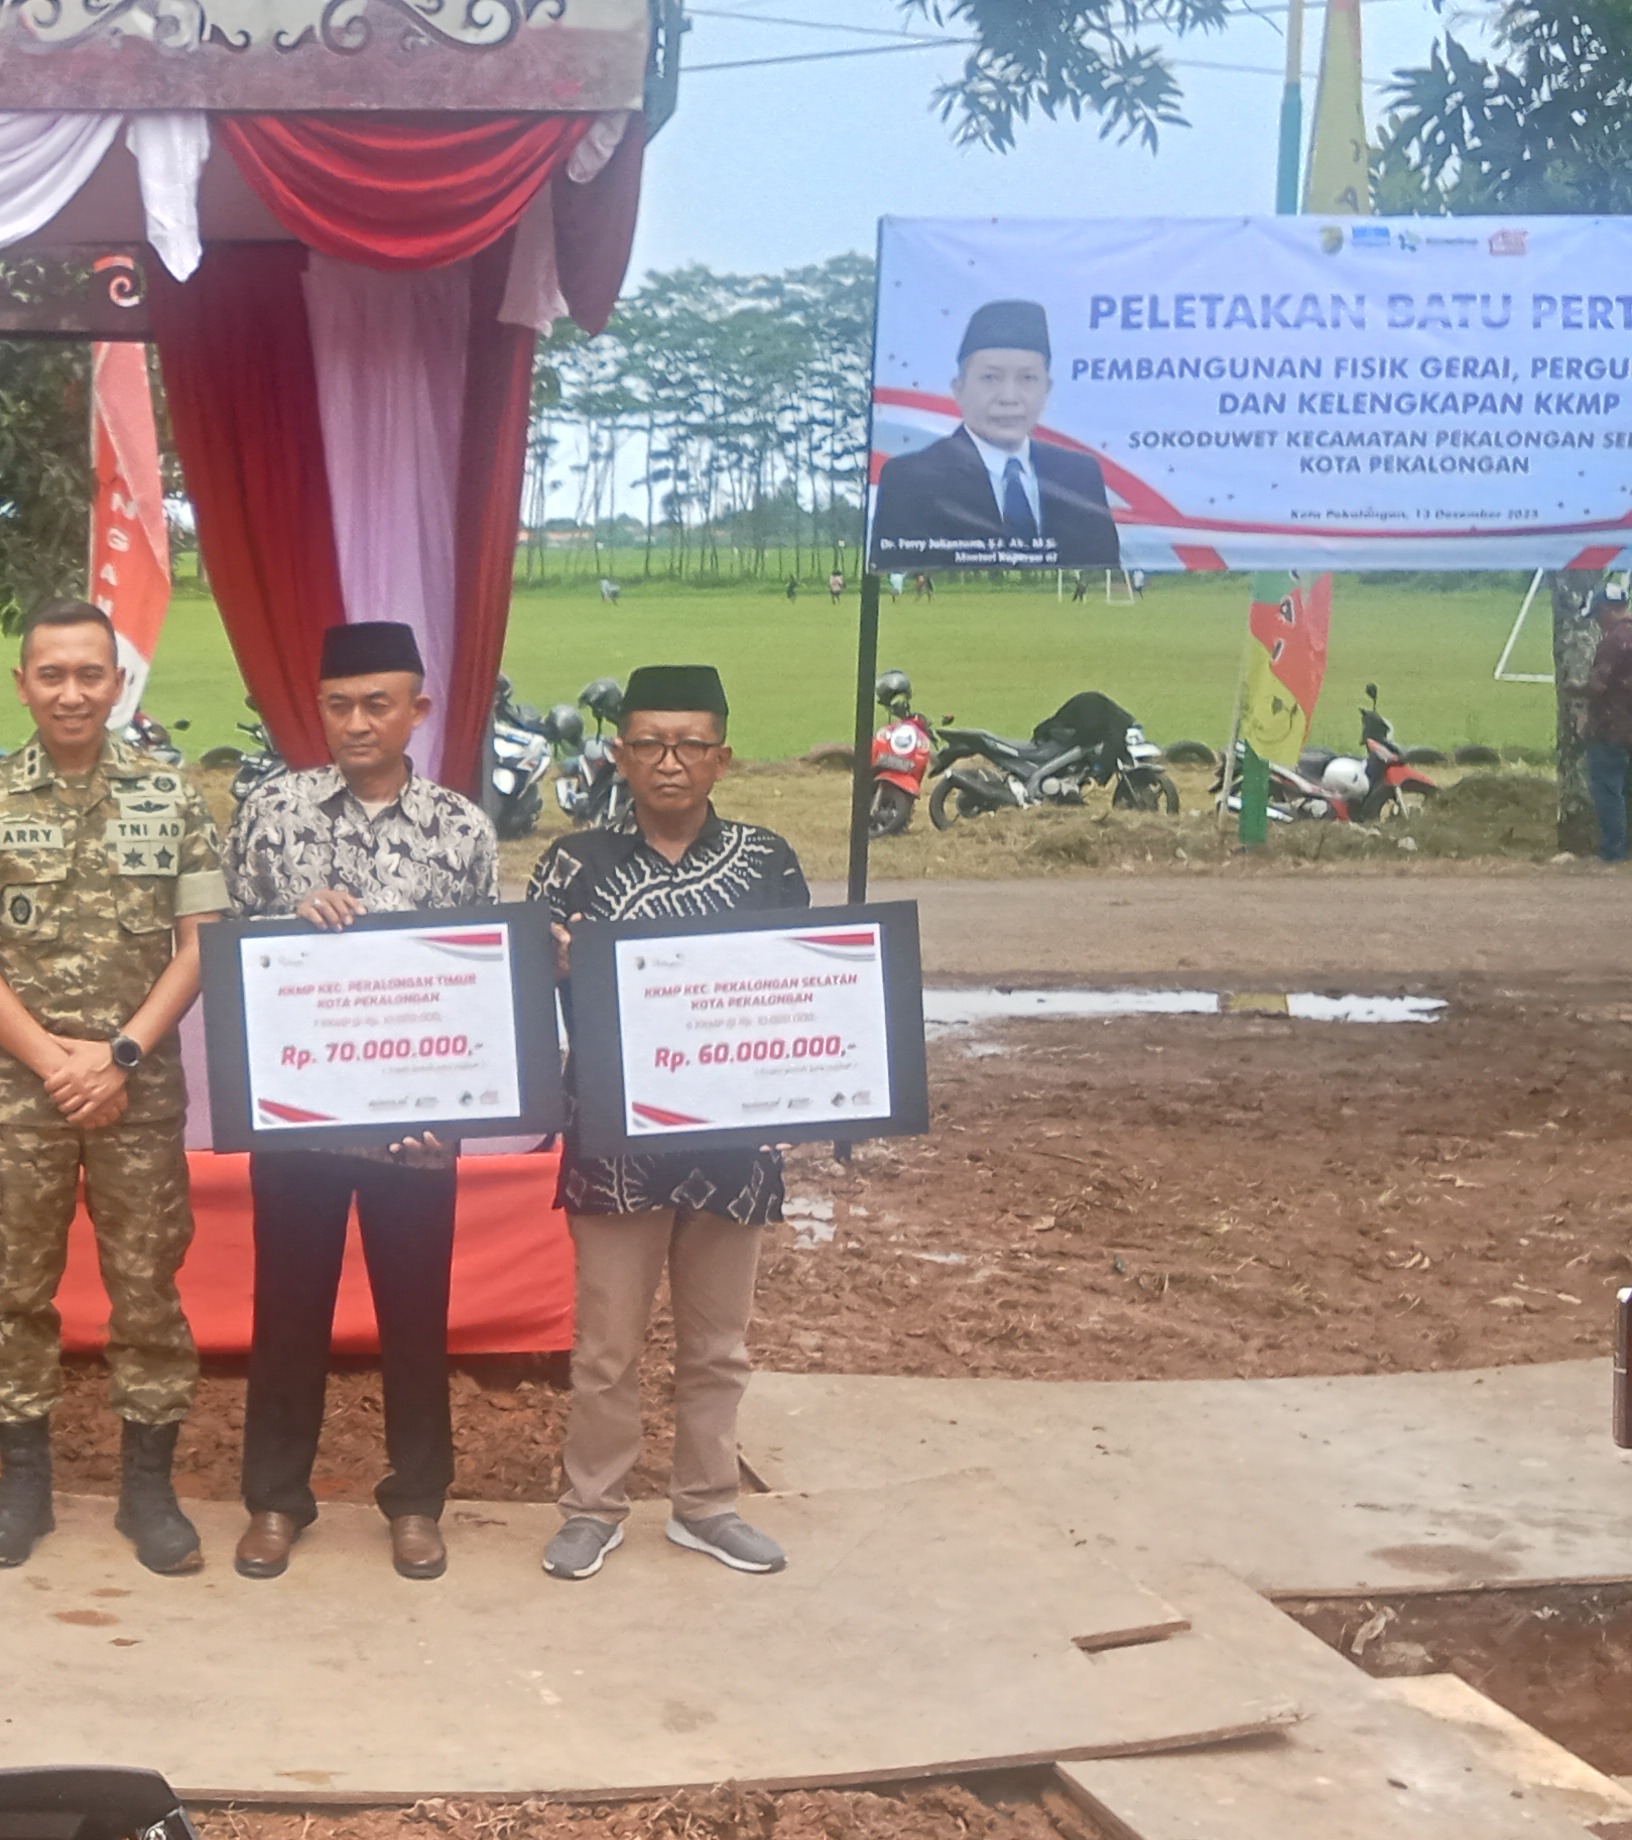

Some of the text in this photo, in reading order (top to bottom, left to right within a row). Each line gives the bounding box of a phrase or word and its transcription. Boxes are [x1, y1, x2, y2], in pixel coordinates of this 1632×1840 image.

[1088, 293, 1366, 330] PELETAKAN
[1386, 293, 1512, 330] BATU
[1071, 355, 1631, 383] PEMBANGUNAN FISIK GERAI, PERGU
[1218, 391, 1621, 415] DAN KELENGKAPAN KKMP
[1128, 430, 1279, 449] SOKODUWET
[1286, 430, 1427, 449] KECAMATAN
[1435, 430, 1595, 449] PEKALONGAN
[1299, 455, 1530, 474] KOTA PEKALONGAN
[118, 823, 180, 837] TNI AD
[278, 984, 316, 997] KKMP
[348, 975, 434, 992] PEKALONGAN
[436, 972, 477, 986] TIMUR
[644, 986, 682, 999] KKMP
[714, 977, 799, 994] PEKALONGAN
[801, 973, 858, 988] SELATAN
[316, 991, 440, 1009] KOTA PEKALONGAN
[691, 992, 814, 1011] KOTA PEKALONGAN
[281, 1034, 484, 1071] Rp. 70.000.000,-
[654, 1035, 857, 1073] Rp. 60.000.000,-
